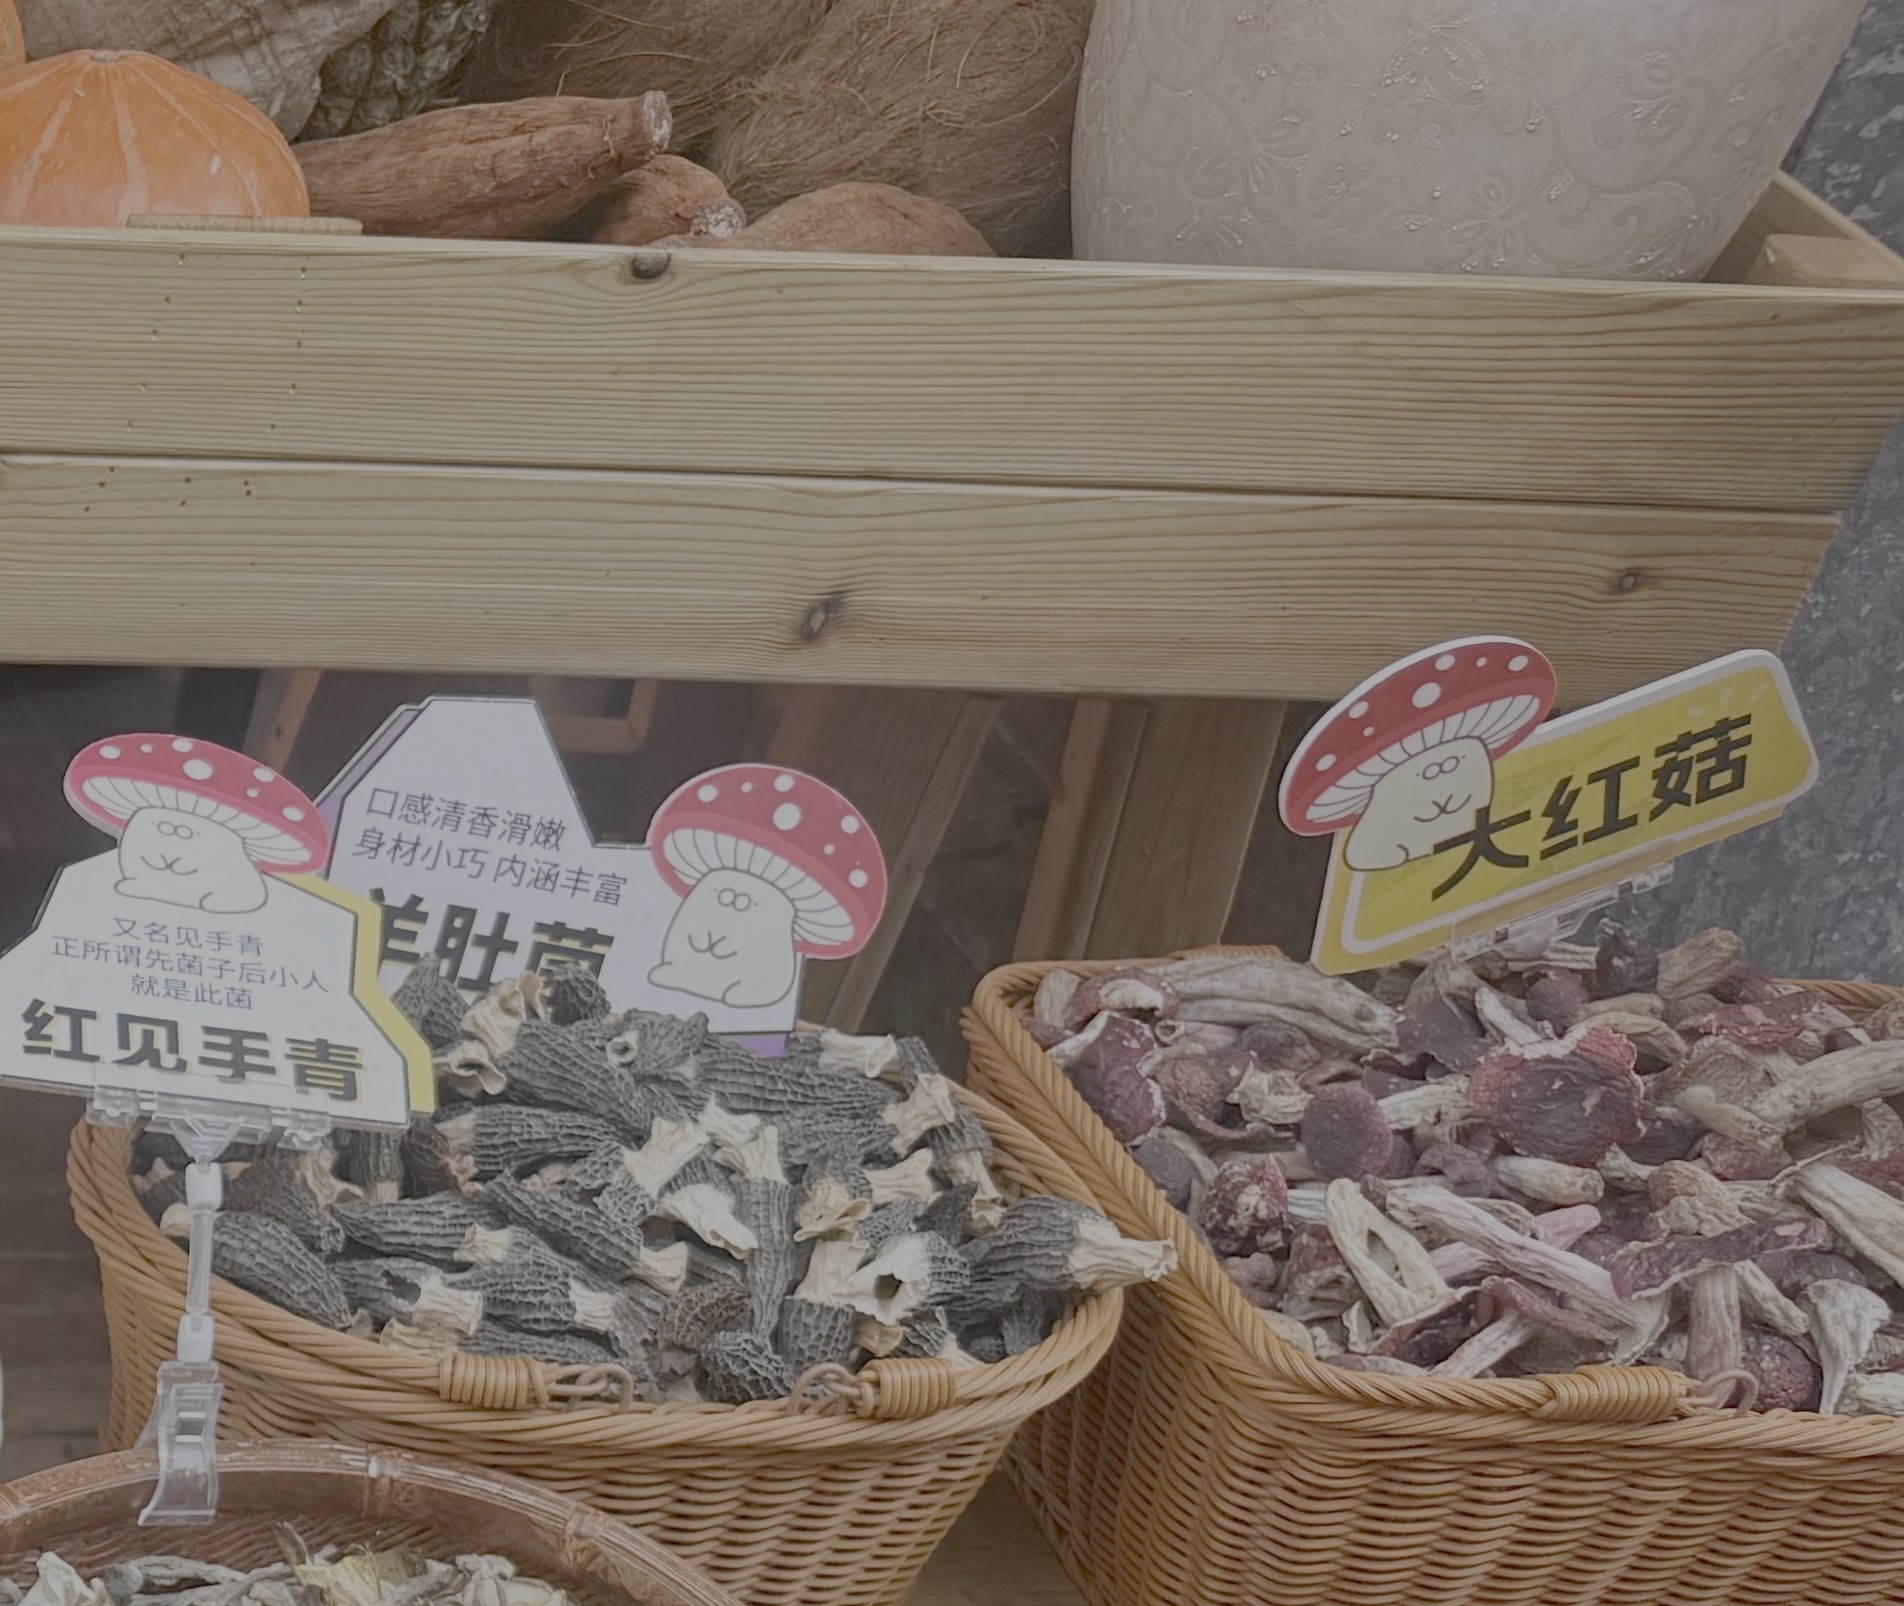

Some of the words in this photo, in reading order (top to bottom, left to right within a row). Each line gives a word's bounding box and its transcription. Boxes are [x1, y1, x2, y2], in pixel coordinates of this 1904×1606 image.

[366, 787, 567, 852] 口感清香滑嫩
[1431, 713, 1753, 902] 大红菇
[352, 827, 490, 879] 身材小巧
[493, 853, 627, 906] 内涵丰富
[52, 935, 329, 994] 正所谓先菌子后小人
[113, 917, 264, 957] 又名见手青
[131, 974, 252, 1010] 就是此菌
[22, 998, 363, 1101] 红见手青
